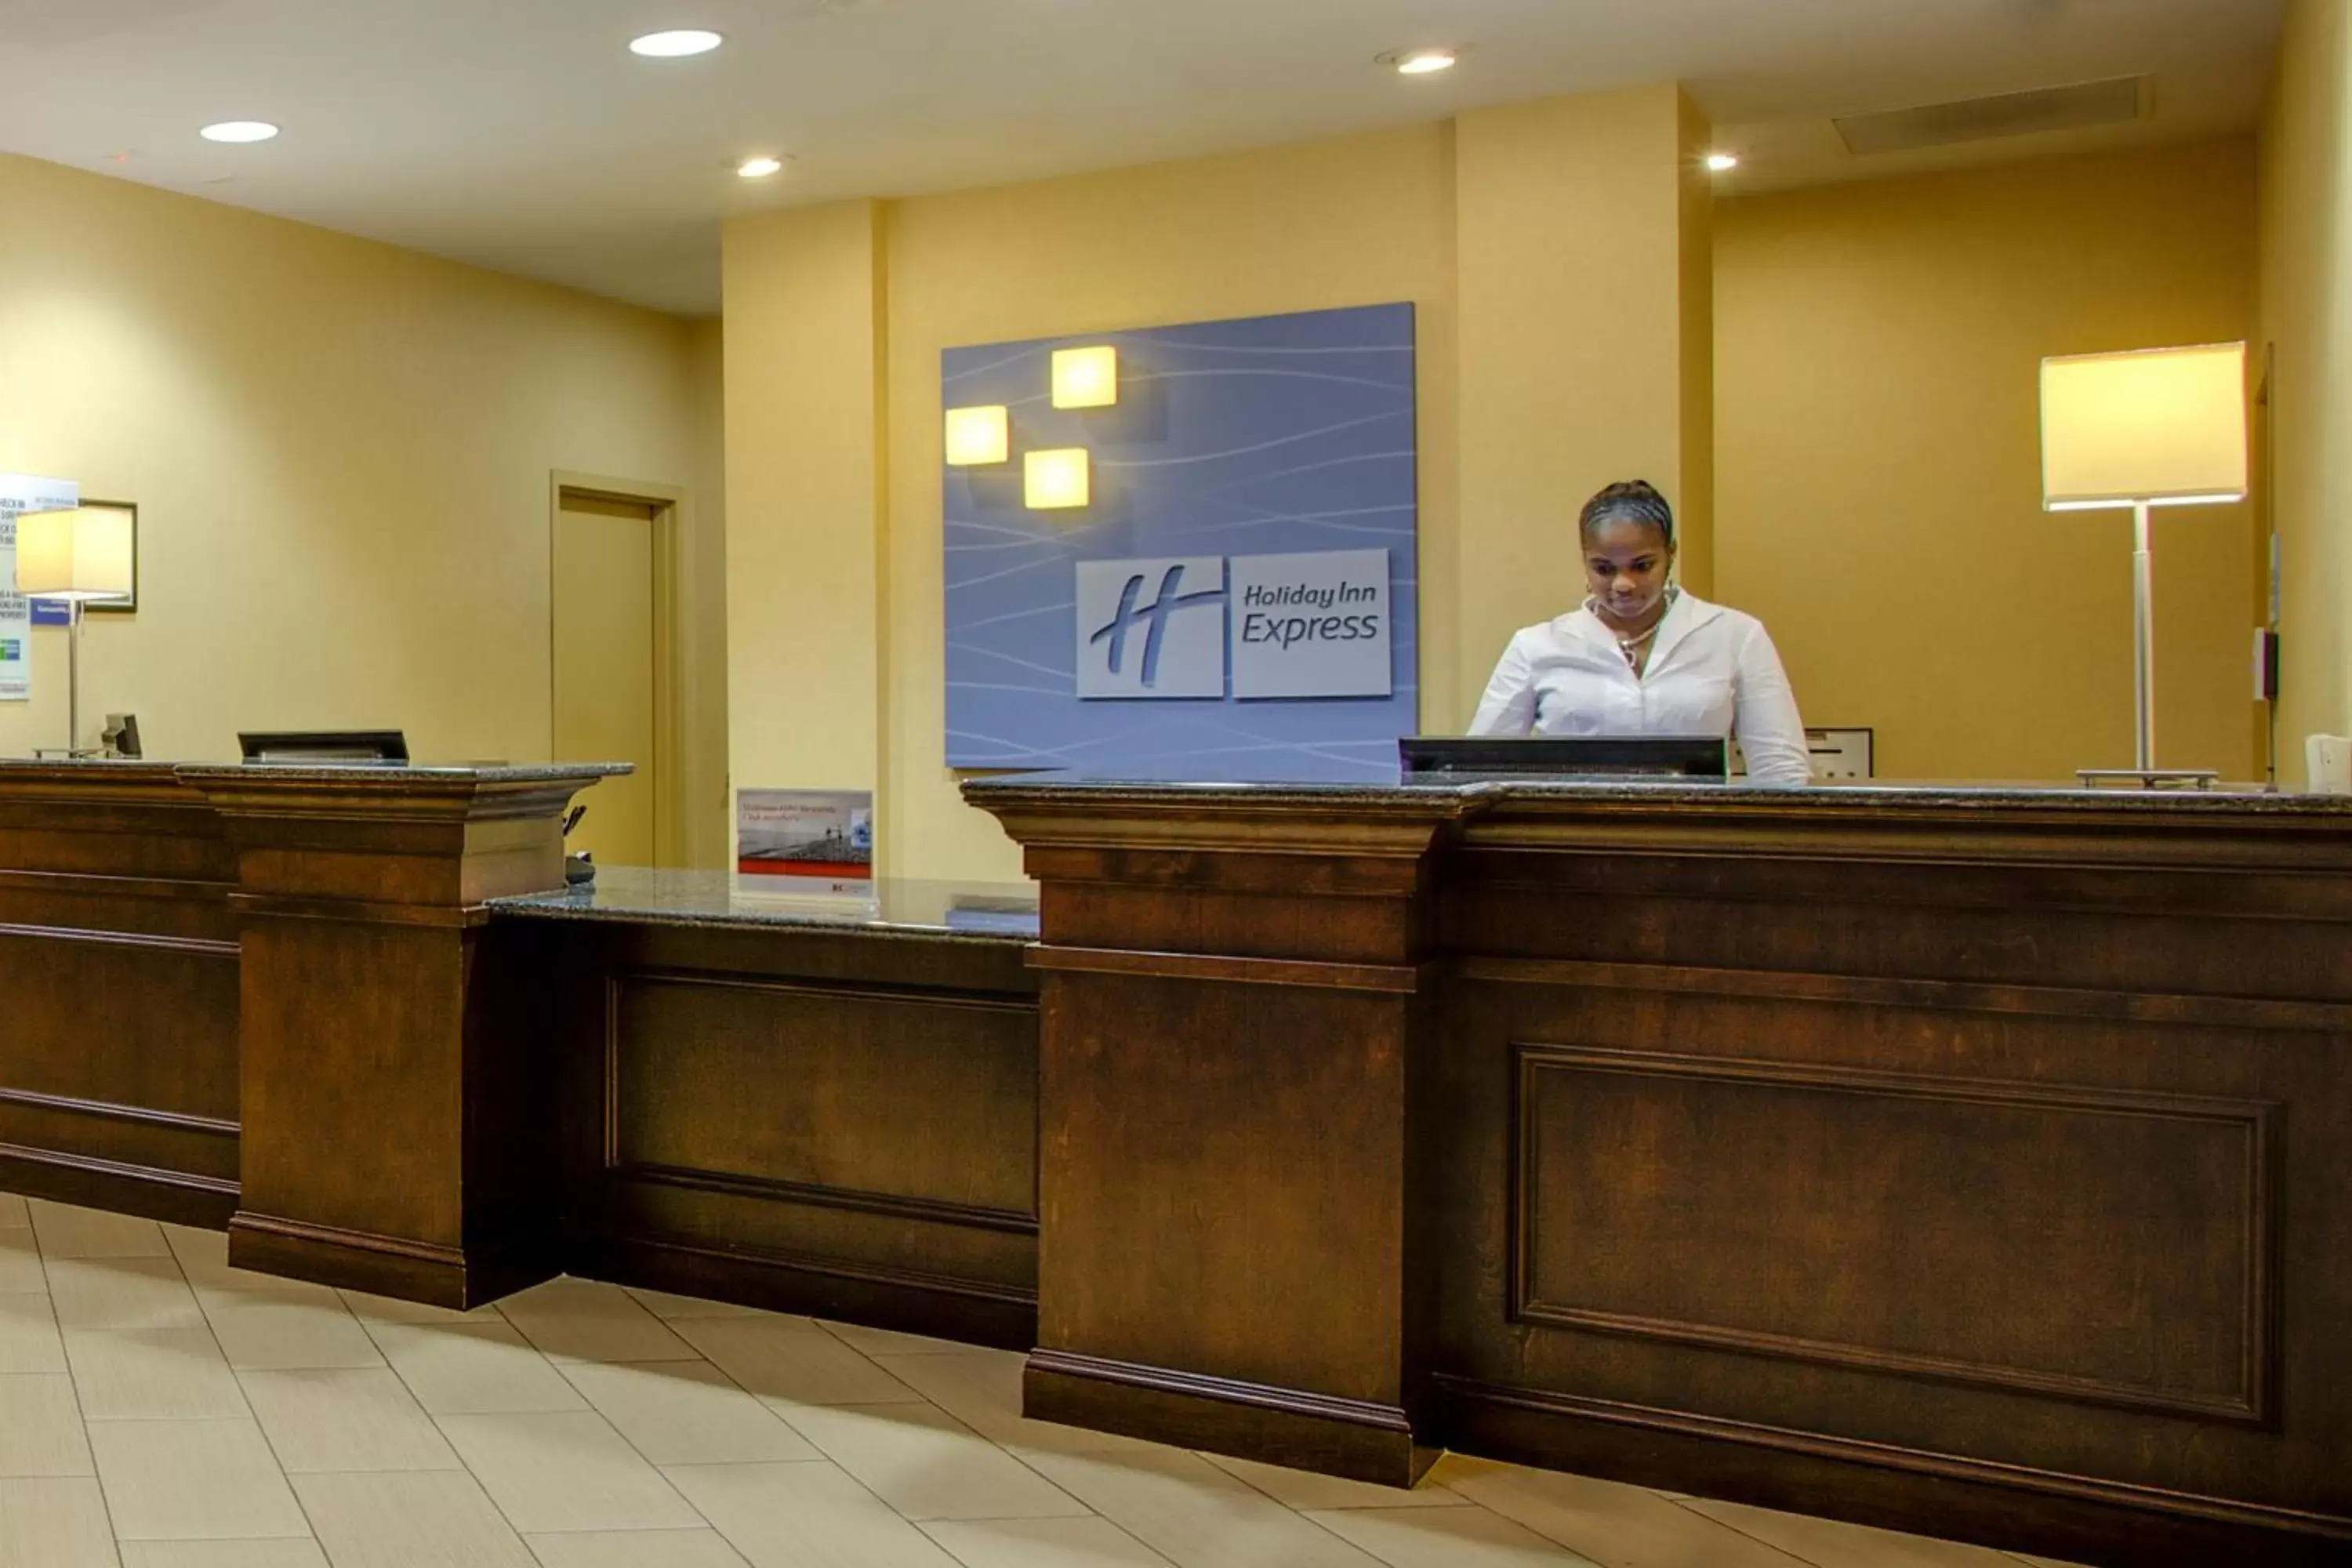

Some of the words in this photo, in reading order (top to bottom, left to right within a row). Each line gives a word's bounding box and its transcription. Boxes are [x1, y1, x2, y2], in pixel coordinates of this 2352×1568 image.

[1243, 583, 1334, 609] Holiday
[1338, 581, 1377, 602] Inn
[1242, 613, 1379, 651] Express
